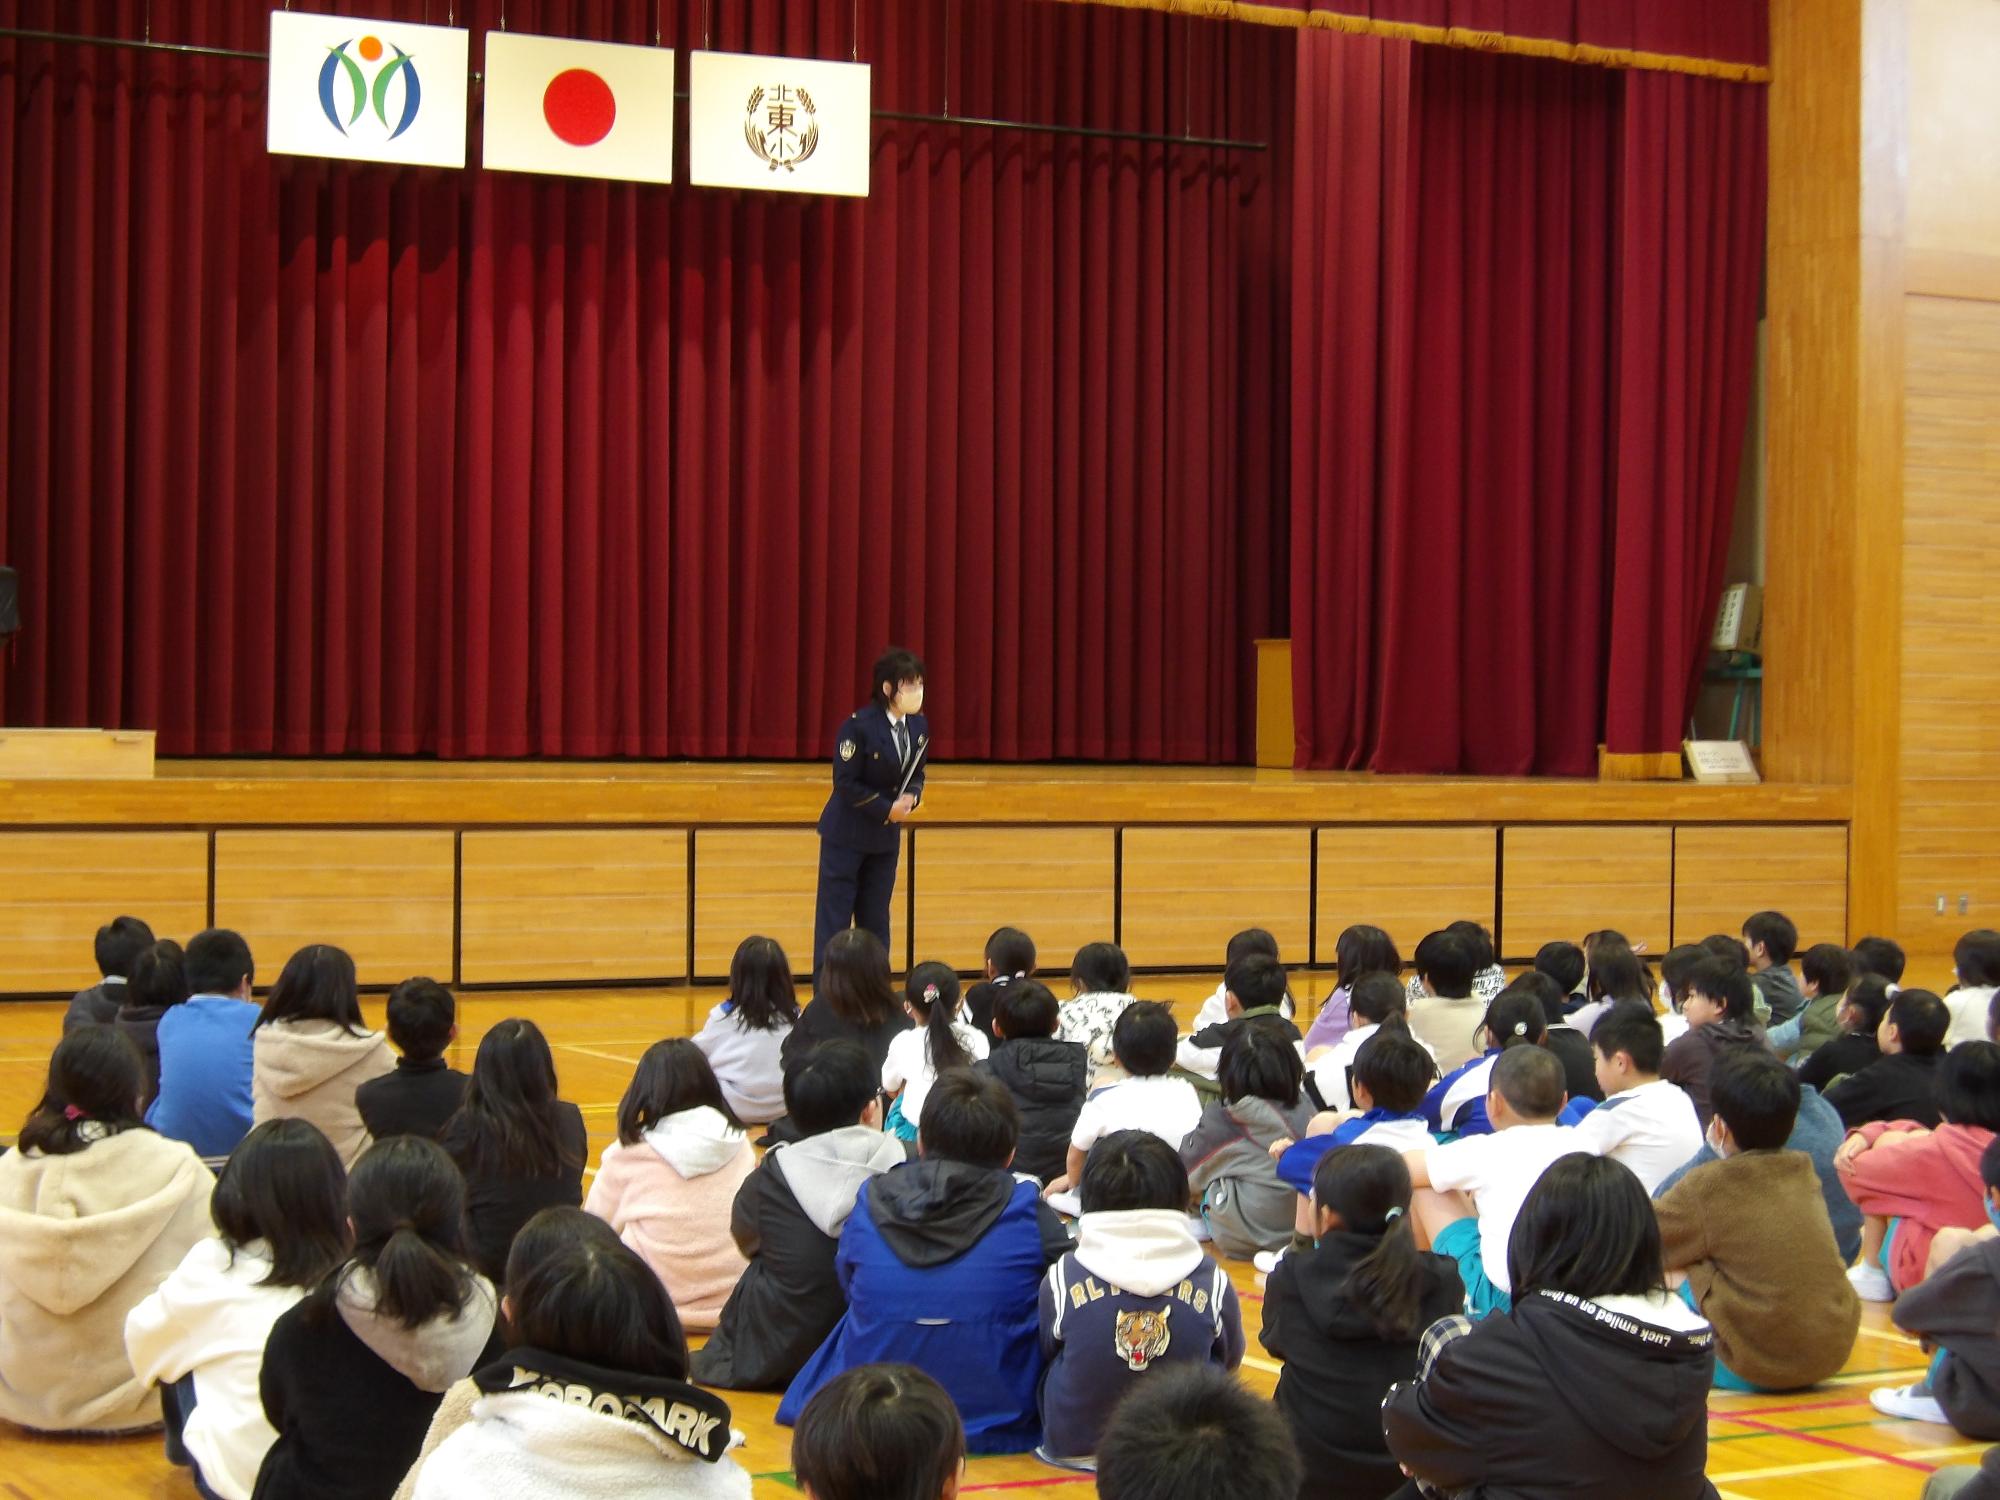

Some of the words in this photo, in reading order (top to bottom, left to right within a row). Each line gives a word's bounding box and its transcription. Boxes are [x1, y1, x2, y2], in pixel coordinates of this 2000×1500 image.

[767, 84, 797, 158] 北東小
[1579, 1300, 1597, 1316] on
[1595, 1309, 1639, 1335] smiled
[1640, 1327, 1671, 1348] Luck
